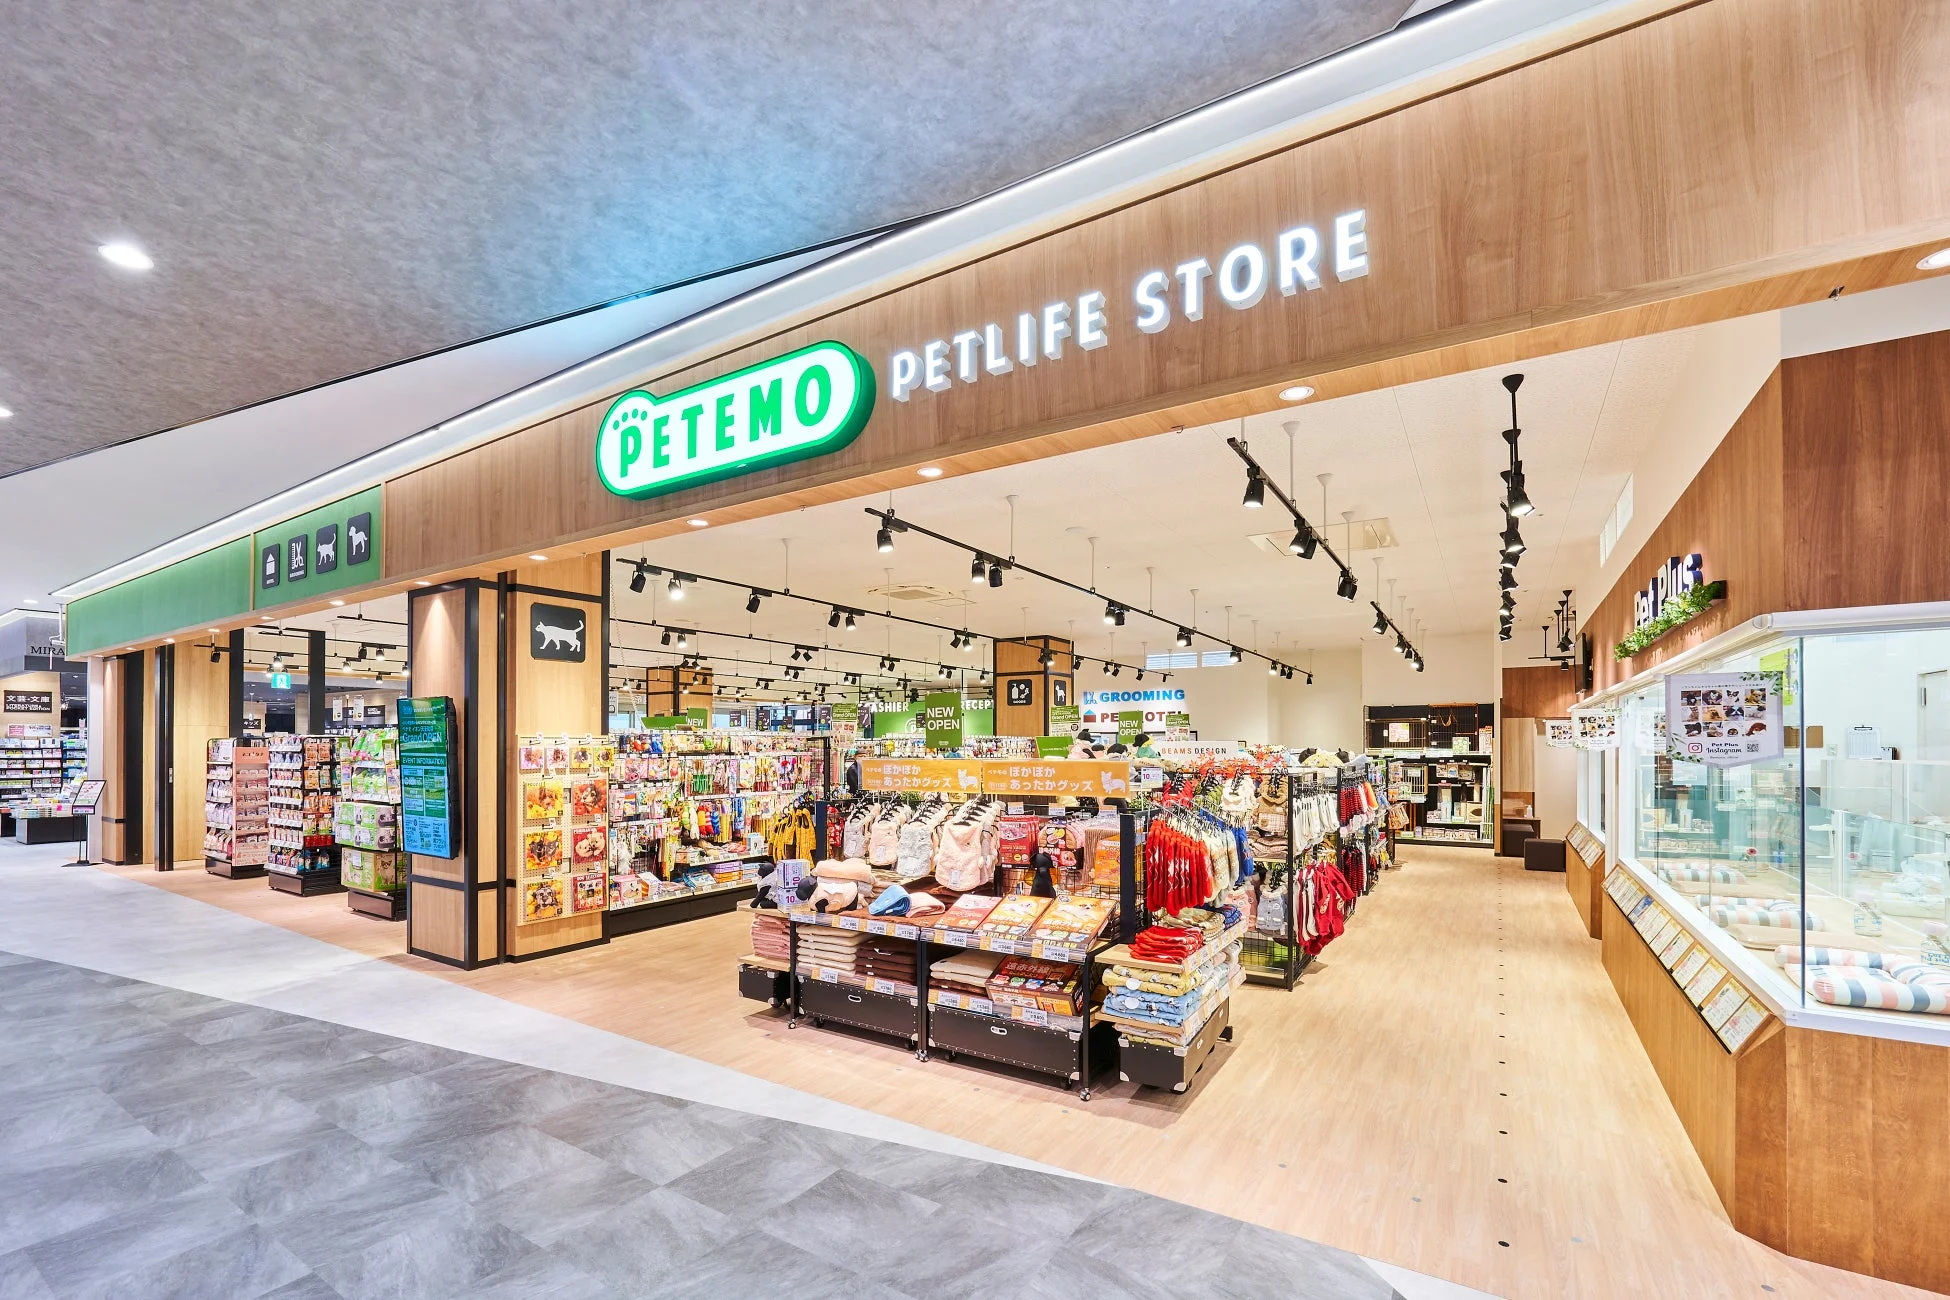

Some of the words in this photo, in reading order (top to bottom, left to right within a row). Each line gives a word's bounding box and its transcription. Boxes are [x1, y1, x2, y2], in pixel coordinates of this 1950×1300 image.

[892, 291, 1107, 402] PETLIFE
[1136, 209, 1368, 333] STORE
[620, 364, 832, 478] PETEMO
[1634, 576, 1658, 629] Pet
[1658, 554, 1703, 614] Plus
[1100, 689, 1185, 703] GROOMING
[927, 707, 954, 718] NEW
[687, 718, 704, 727] NEW
[927, 719, 960, 731] OPEN
[1120, 720, 1138, 728] NEW
[402, 732, 423, 743] Grand
[423, 732, 442, 742] OPEN
[1120, 728, 1142, 736] OPEN
[1706, 746, 1742, 755] Instagram
[417, 757, 444, 765] INFORMATION
[884, 776, 952, 788] あったかグッズ
[1010, 780, 1094, 793] あったかグッズ
[786, 895, 795, 903] 10
